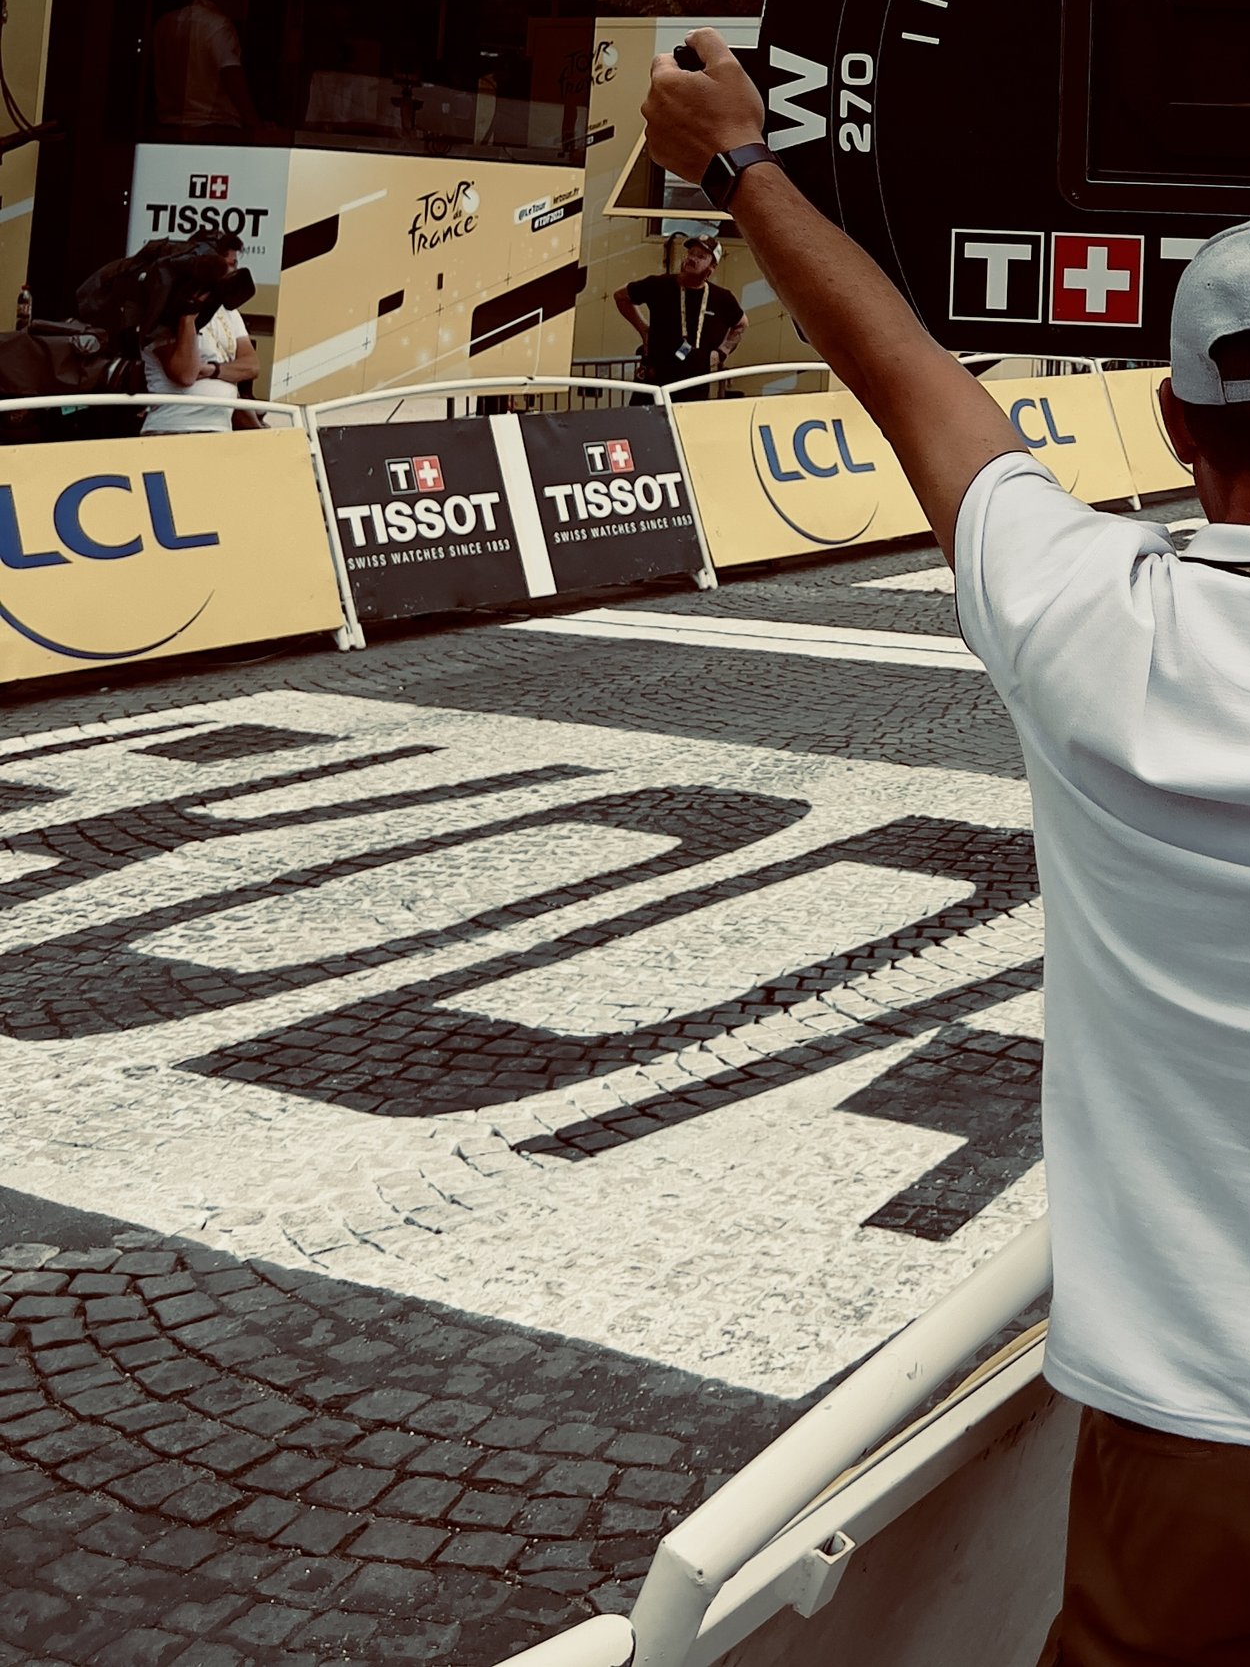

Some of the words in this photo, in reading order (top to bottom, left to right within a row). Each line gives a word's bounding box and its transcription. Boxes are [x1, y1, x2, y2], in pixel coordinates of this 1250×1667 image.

[768, 46, 828, 151] W
[839, 54, 874, 152] 270
[146, 204, 268, 237] TISSOT
[416, 181, 474, 224] TOUR
[408, 213, 478, 256] france
[1009, 397, 1077, 450] CL
[758, 419, 876, 482] LCL
[0, 471, 219, 571] LCL
[337, 492, 501, 547] TISSOT
[544, 472, 683, 523] TISSOT
[348, 554, 387, 571] SWISS
[391, 545, 445, 565] WATCHES
[449, 539, 483, 557] SINCE
[486, 537, 511, 553] 1853
[554, 529, 588, 544] SWISS
[591, 522, 636, 538] WATCHES
[640, 517, 669, 532] SINCE
[672, 514, 693, 526] 1853
